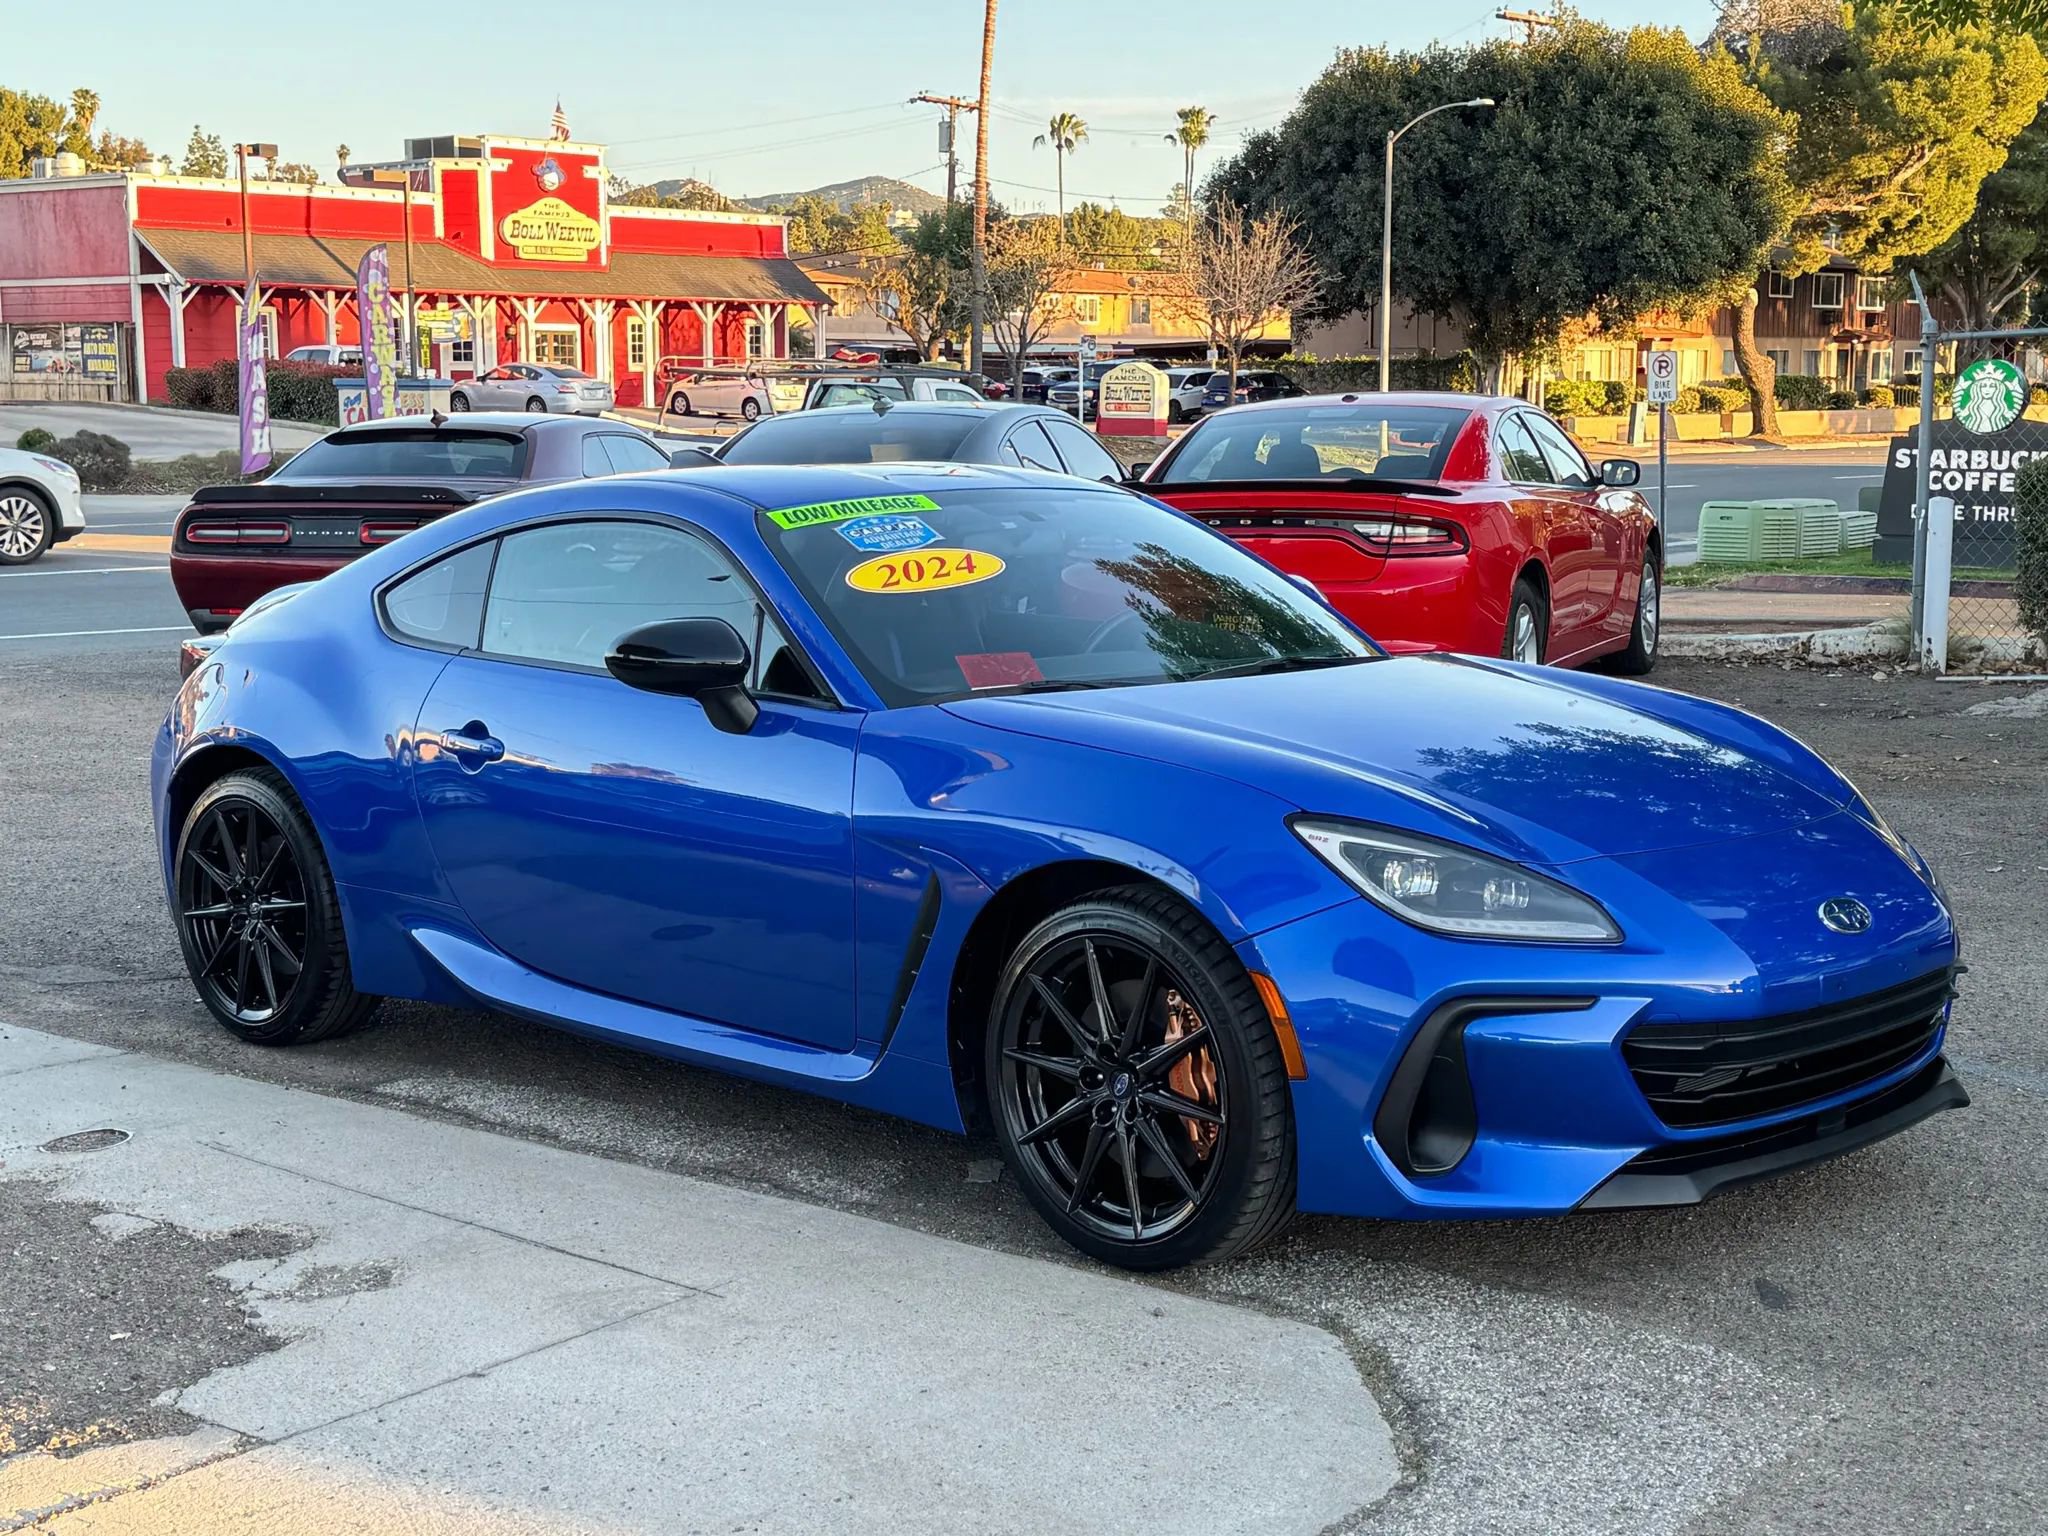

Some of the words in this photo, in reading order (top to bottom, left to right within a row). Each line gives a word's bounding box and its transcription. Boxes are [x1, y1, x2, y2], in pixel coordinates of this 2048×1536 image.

[510, 219, 544, 240] BOLL
[545, 221, 596, 243] WEEVIL
[1652, 390, 1673, 400] LANE
[1654, 380, 1671, 390] BIKE
[1929, 470, 2016, 492] COFFE
[782, 504, 830, 525] LOW
[831, 496, 920, 516] MILEAGE
[880, 538, 925, 549] DEALER
[876, 552, 977, 589] 2024
